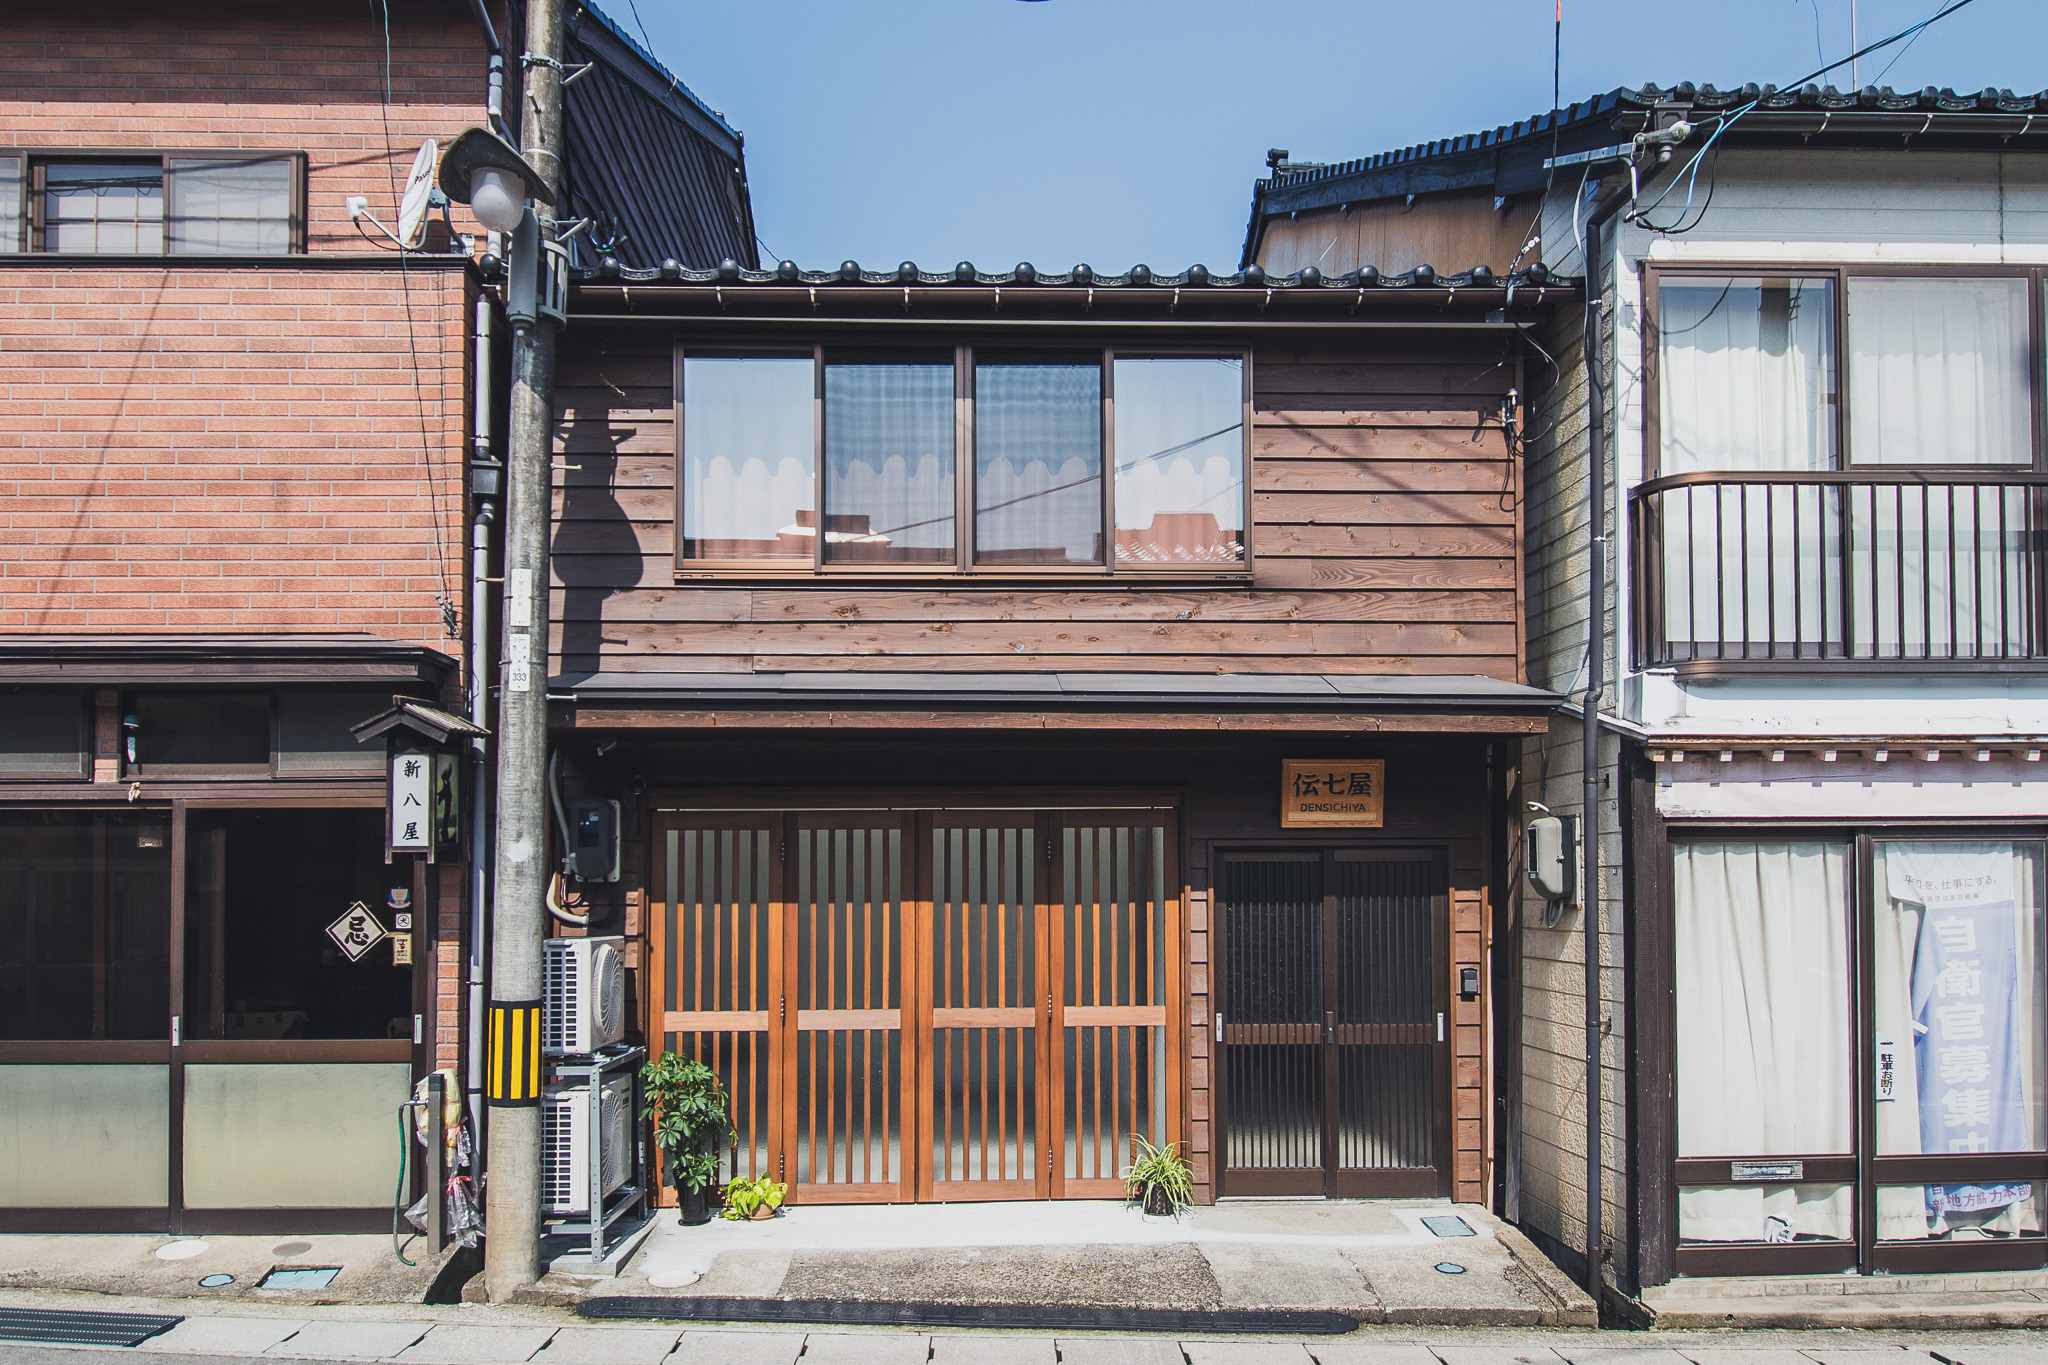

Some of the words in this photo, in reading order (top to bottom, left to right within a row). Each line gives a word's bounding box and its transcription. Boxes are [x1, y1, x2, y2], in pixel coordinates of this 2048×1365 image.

[512, 672, 527, 682] 333
[1293, 772, 1373, 798] 伝七屋
[402, 759, 422, 841] 新八屋
[1300, 802, 1367, 813] DENSICHIYA
[344, 915, 370, 947] 忌
